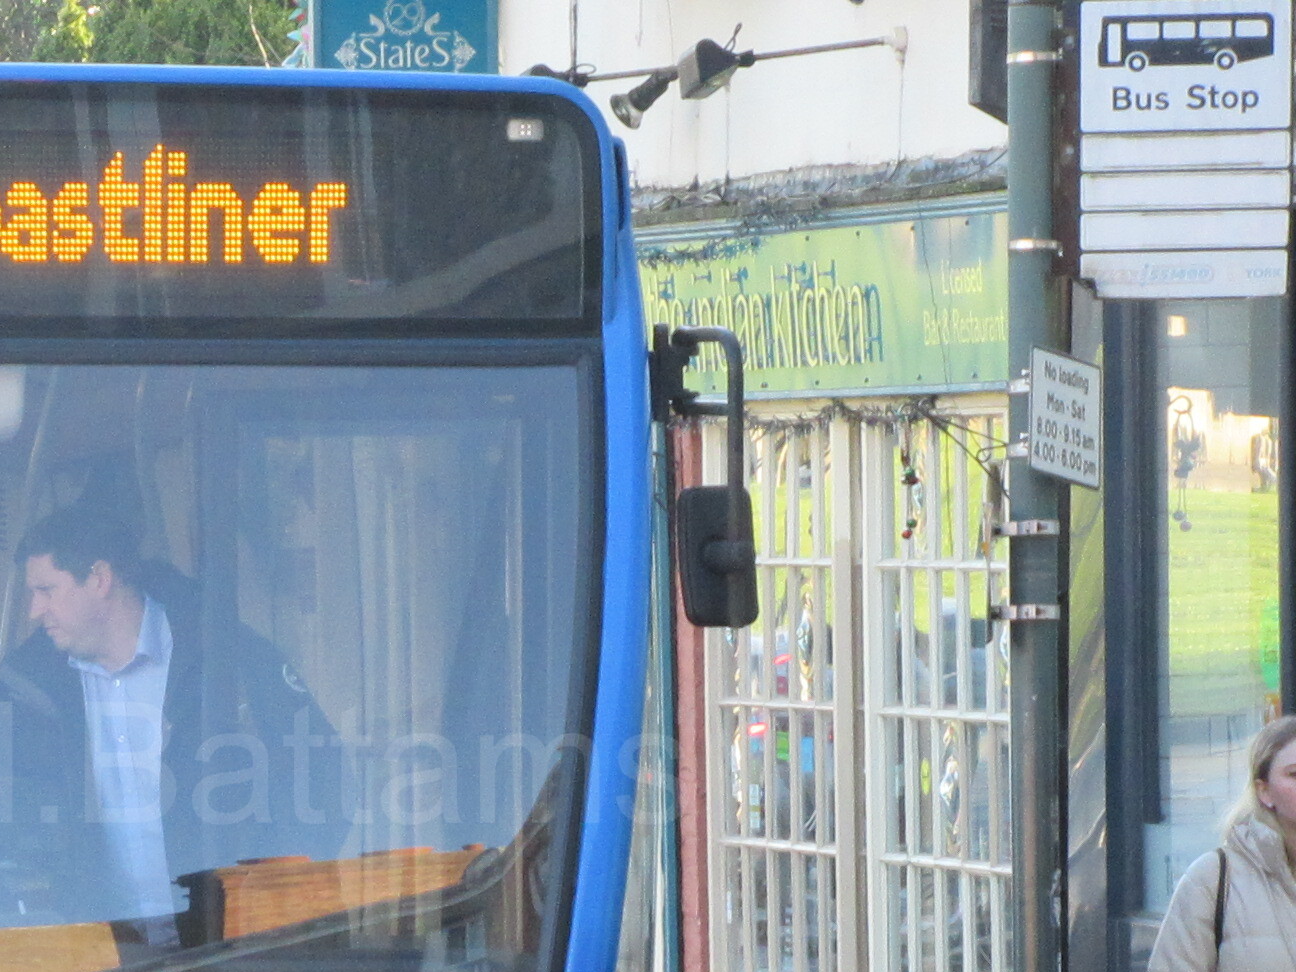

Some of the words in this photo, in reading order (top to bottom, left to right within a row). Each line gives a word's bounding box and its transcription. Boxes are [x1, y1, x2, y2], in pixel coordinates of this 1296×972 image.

[389, 2, 419, 26] 29
[1112, 86, 1170, 111] Bus
[1186, 84, 1260, 113] Stop
[770, 261, 865, 368] kitchen
[1044, 360, 1056, 381] No
[1059, 365, 1089, 395] loading
[1047, 392, 1065, 414] Mon
[1071, 399, 1086, 421] Sat
[1082, 434, 1095, 450] am
[1083, 459, 1097, 476] pm
